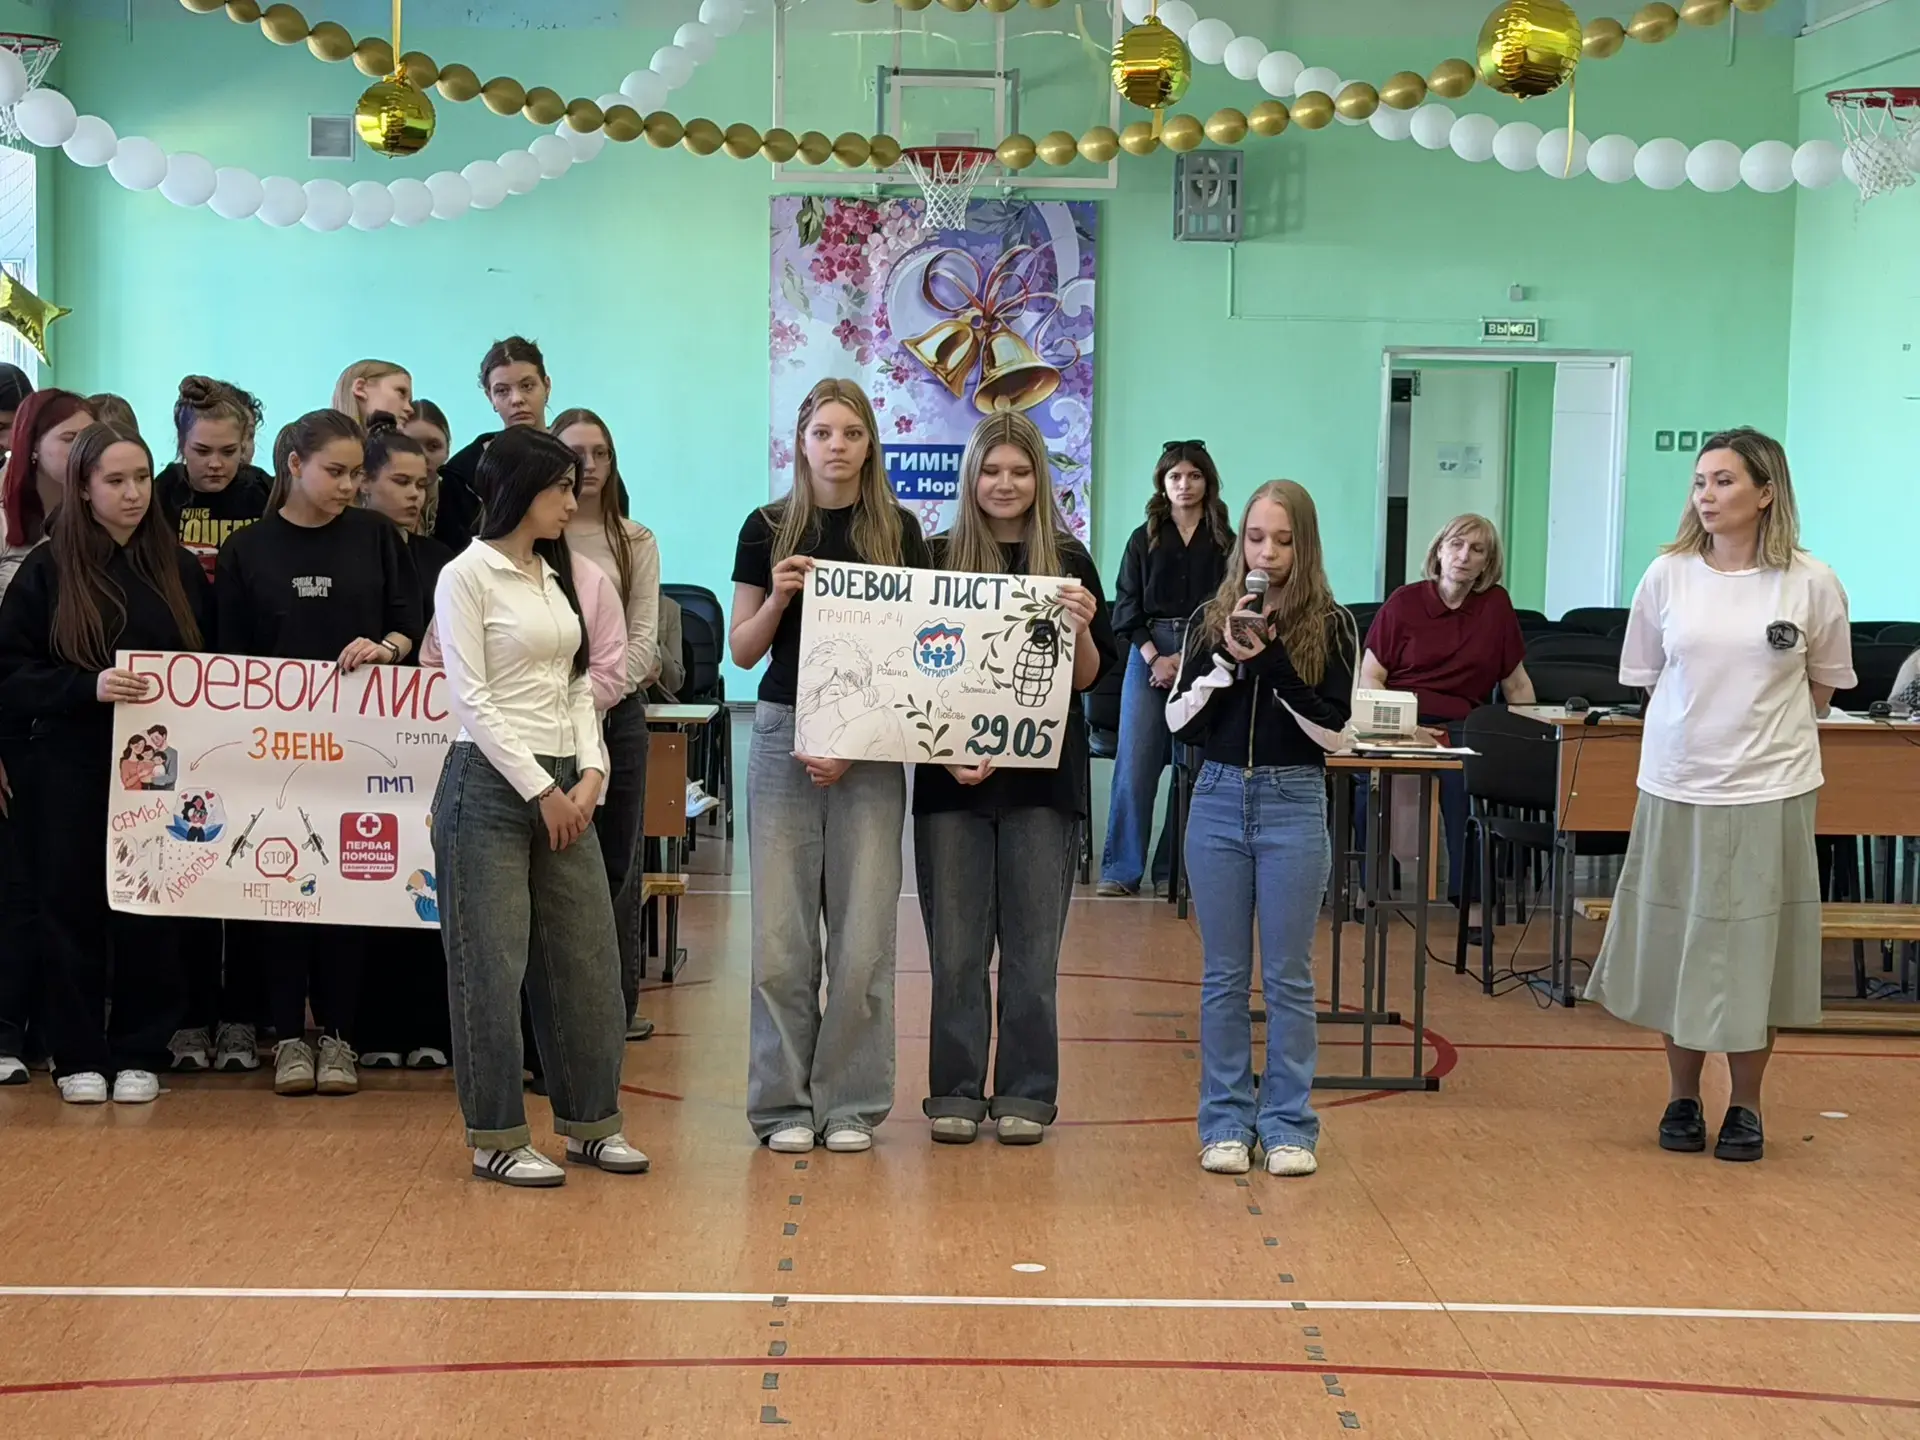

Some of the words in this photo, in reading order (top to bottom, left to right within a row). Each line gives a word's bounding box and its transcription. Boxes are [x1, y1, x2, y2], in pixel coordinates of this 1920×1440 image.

[885, 451, 960, 472] ГИМН
[896, 480, 911, 492] г.
[815, 567, 914, 602] БОЕВОЙ
[929, 575, 1009, 610] ЛИСТ
[818, 608, 871, 624] ГРУППА
[876, 664, 908, 678] Родина
[359, 666, 449, 721] ЛИС
[934, 706, 966, 720] Любовь
[396, 731, 449, 745] ГРУППА
[965, 713, 1060, 759] 29.05
[271, 732, 344, 762] ДЕНЬ
[367, 776, 414, 794] ПМП
[112, 797, 169, 832] СЕМЬЯ
[346, 840, 391, 850] ПЕРВАЯ
[262, 851, 291, 865] STOP
[342, 851, 395, 862] ПОМОЩЬ
[166, 849, 219, 903] ЛЮБОВЬ
[243, 883, 270, 898] НЕТ
